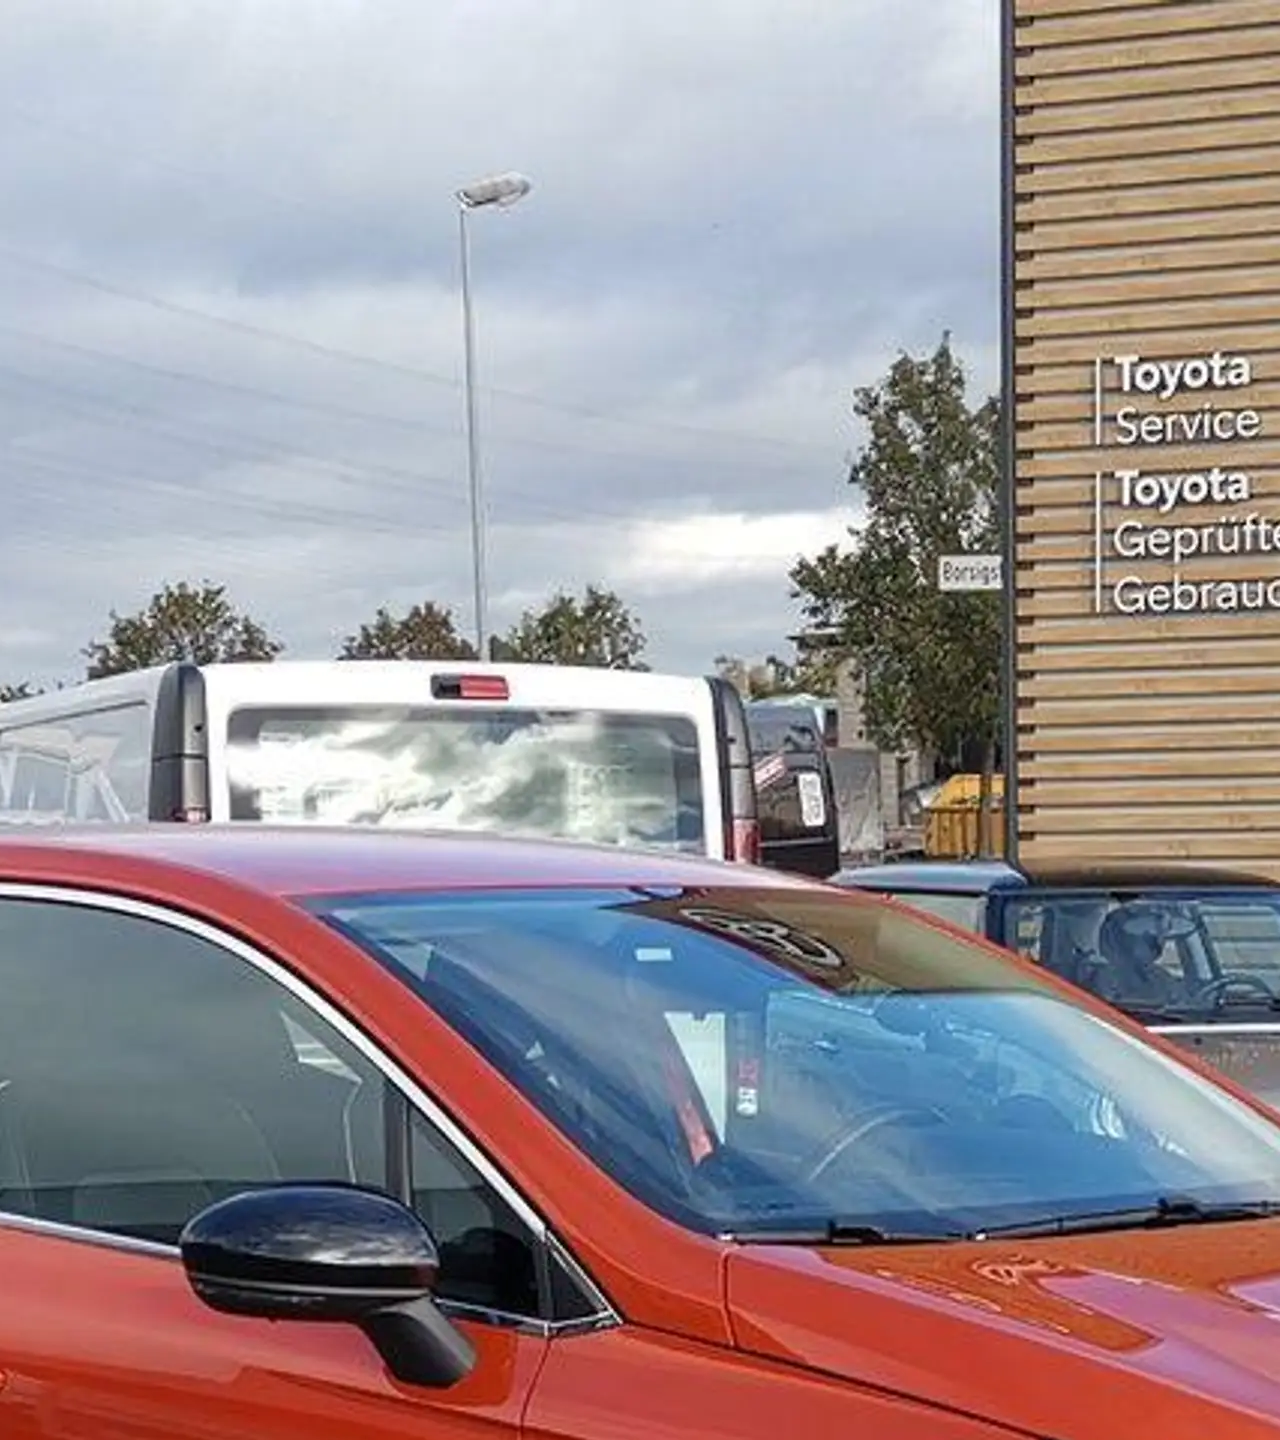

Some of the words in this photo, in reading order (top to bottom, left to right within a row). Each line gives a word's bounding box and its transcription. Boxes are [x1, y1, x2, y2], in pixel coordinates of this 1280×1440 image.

[1114, 352, 1252, 399] Toyota
[1116, 402, 1261, 444] Service
[1114, 468, 1250, 512] Toyota
